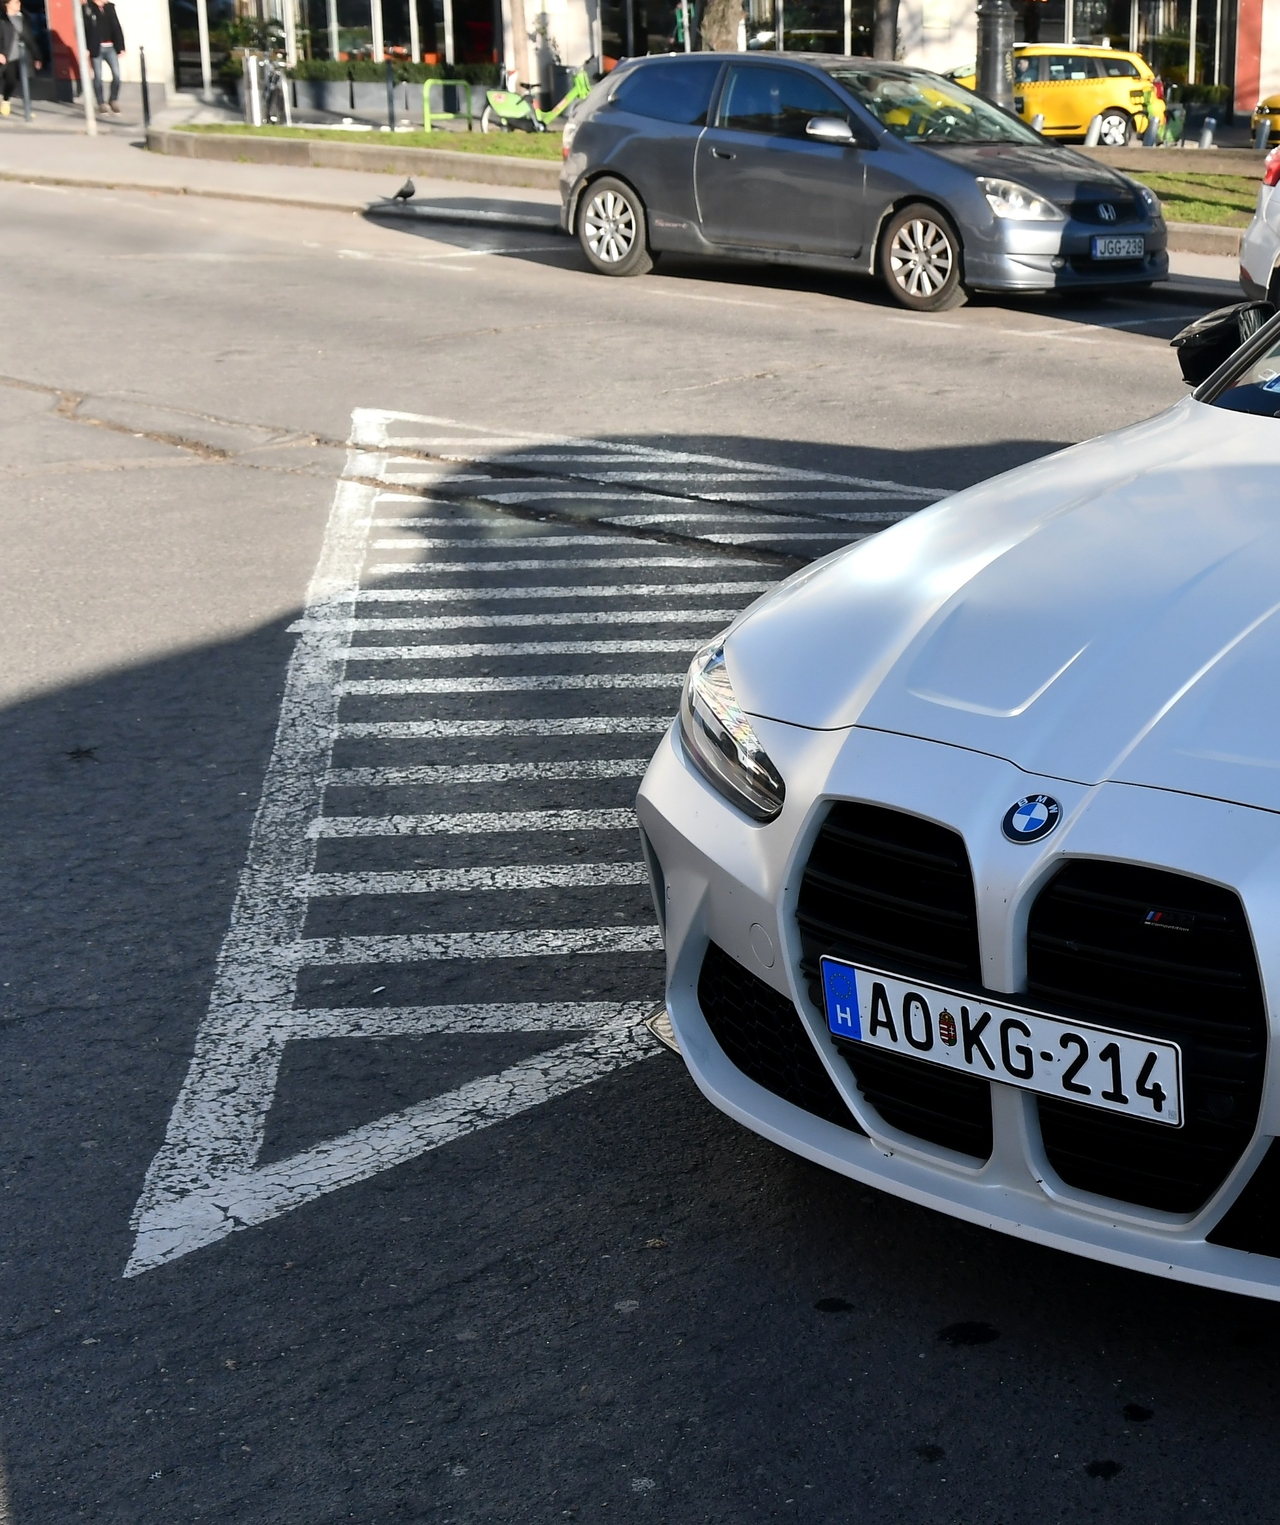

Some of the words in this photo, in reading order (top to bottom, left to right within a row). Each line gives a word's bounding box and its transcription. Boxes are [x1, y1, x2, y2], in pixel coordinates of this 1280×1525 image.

[1100, 240, 1143, 255] JGG-239
[1017, 795, 1059, 813] BMW
[836, 1003, 852, 1027] H
[869, 981, 934, 1051] AO
[960, 1005, 1167, 1113] KG-214
